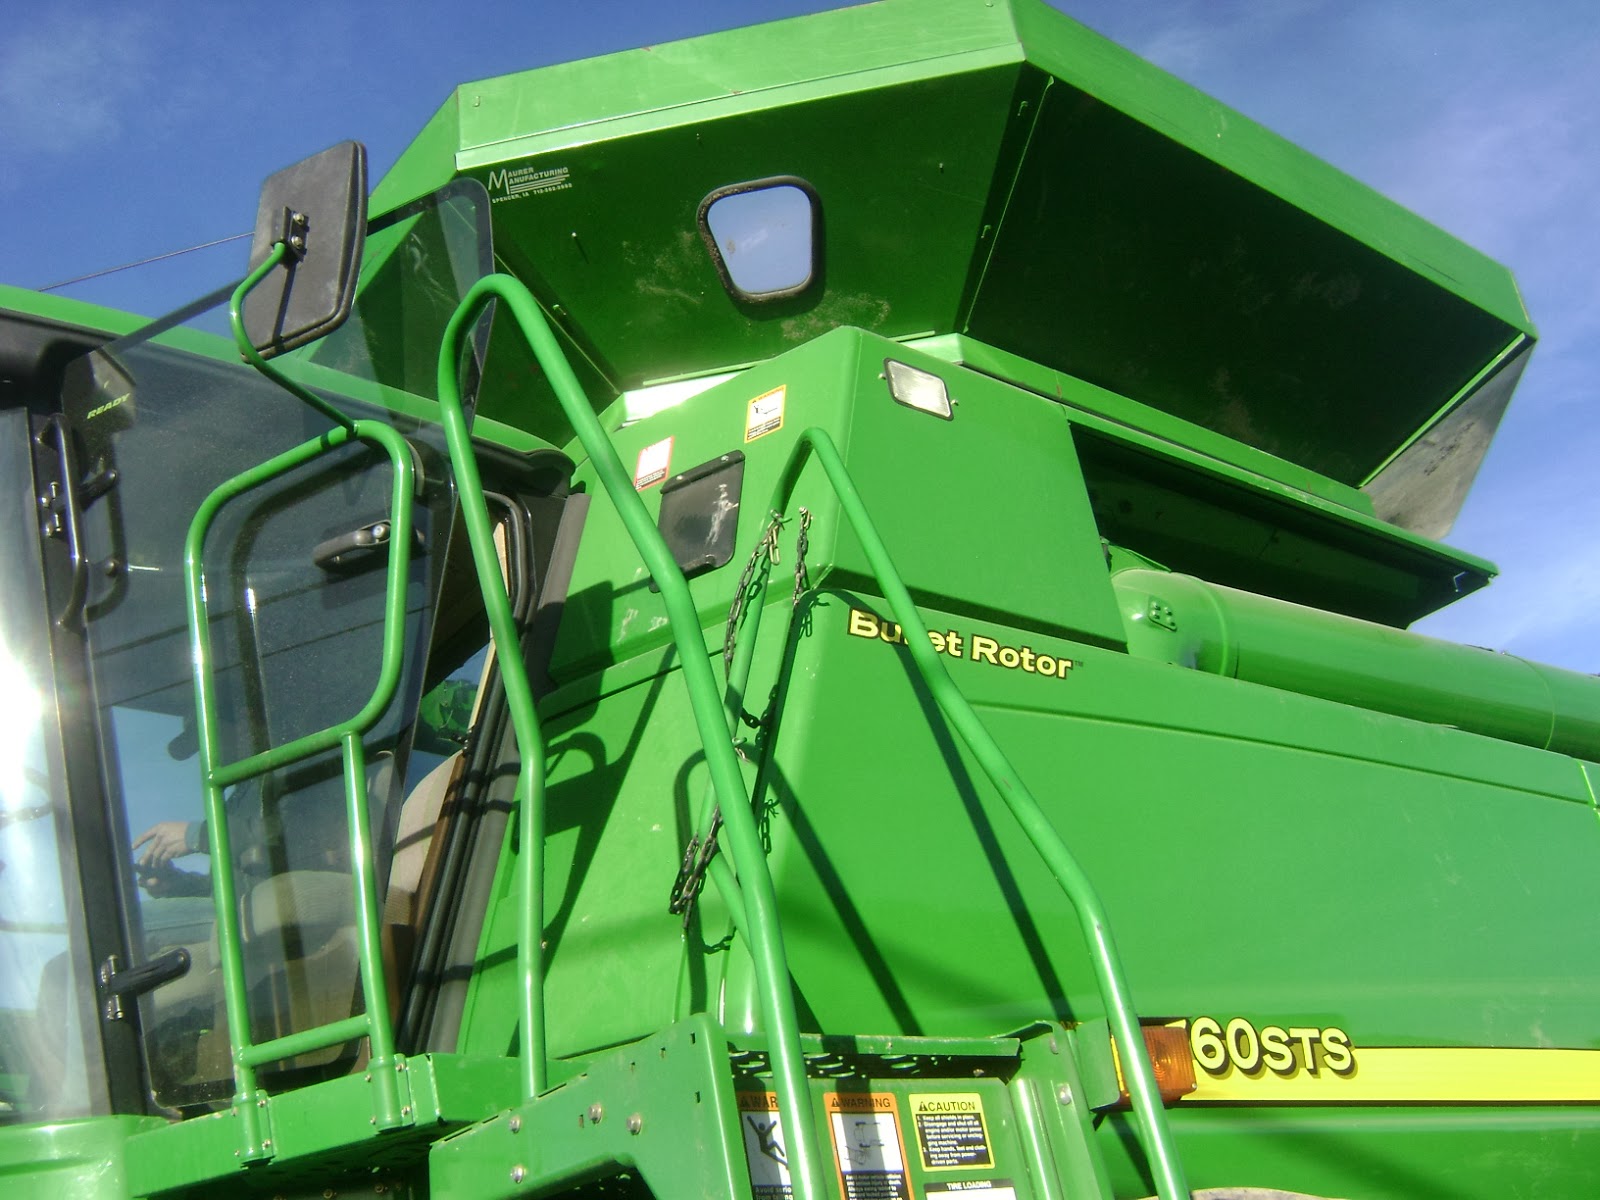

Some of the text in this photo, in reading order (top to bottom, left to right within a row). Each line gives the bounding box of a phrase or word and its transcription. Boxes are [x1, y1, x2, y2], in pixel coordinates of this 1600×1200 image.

[86, 393, 131, 420] READY
[847, 608, 964, 659] Buet
[970, 633, 1073, 680] Rotor
[1166, 1016, 1356, 1076] 60STS
[842, 1097, 891, 1108] WARNING
[928, 1102, 975, 1112] CAUTION
